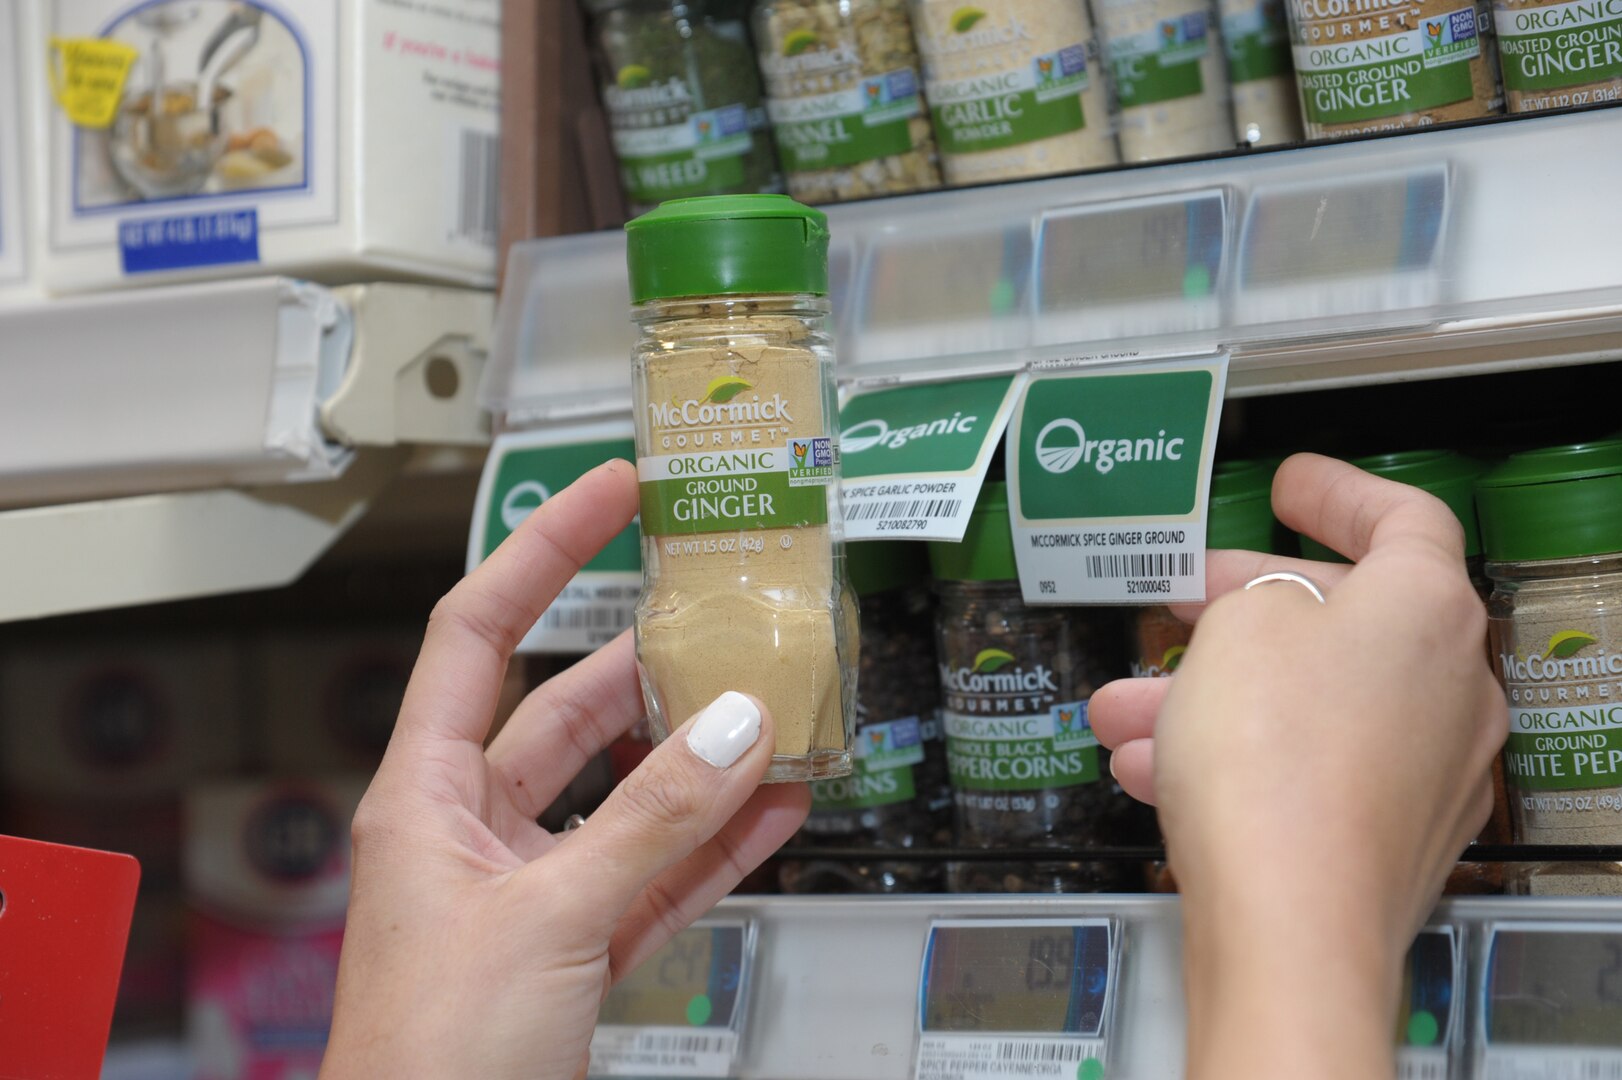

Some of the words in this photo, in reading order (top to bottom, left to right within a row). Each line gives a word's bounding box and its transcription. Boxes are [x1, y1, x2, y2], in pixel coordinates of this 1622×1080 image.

[1451, 12, 1473, 25] NON
[1452, 21, 1475, 34] GMO
[1555, 24, 1622, 49] GROUN
[1309, 37, 1410, 67] ORGANIC
[1426, 38, 1478, 58] VERIFIED
[1521, 41, 1622, 77] GINGER
[1346, 60, 1422, 86] GROUND
[1315, 78, 1411, 112] GINGER
[1572, 91, 1589, 106] OZ
[941, 93, 1024, 128] GARLIC
[648, 393, 793, 427] McCormick
[814, 440, 831, 450] NON
[815, 449, 831, 458] GMO
[1035, 417, 1185, 475] Organic
[668, 452, 775, 475] ORGANIC
[792, 467, 832, 477] VERIFIED
[686, 477, 757, 496] GROUND
[849, 486, 877, 499] SPICE
[877, 484, 912, 497] GARLIC
[912, 482, 957, 494] POWDER
[673, 493, 776, 522] GINGER
[876, 519, 928, 531] 5210082790
[665, 541, 682, 557] NET
[683, 539, 700, 555] WT
[702, 539, 716, 554] 1.5
[719, 538, 736, 552] OZ
[739, 536, 764, 554] (42g)
[1031, 531, 1082, 548] MCCORMICK
[1083, 532, 1107, 546] SPICE
[1108, 531, 1142, 546] GINGER
[1144, 530, 1186, 545] GROUND
[1039, 580, 1057, 594] 0952
[1127, 580, 1172, 594] 5210000453
[1500, 649, 1622, 681] McCormic
[951, 718, 1040, 737] ORGANIC
[995, 740, 1048, 757] BLACK
[1535, 735, 1607, 752] GROUND
[1506, 754, 1565, 776] WHITE
[1535, 797, 1550, 811] WT
[1554, 797, 1573, 811] 1.75
[1575, 796, 1593, 811] OZ
[919, 1059, 949, 1072] SPICE
[950, 1060, 990, 1073] PEPPER
